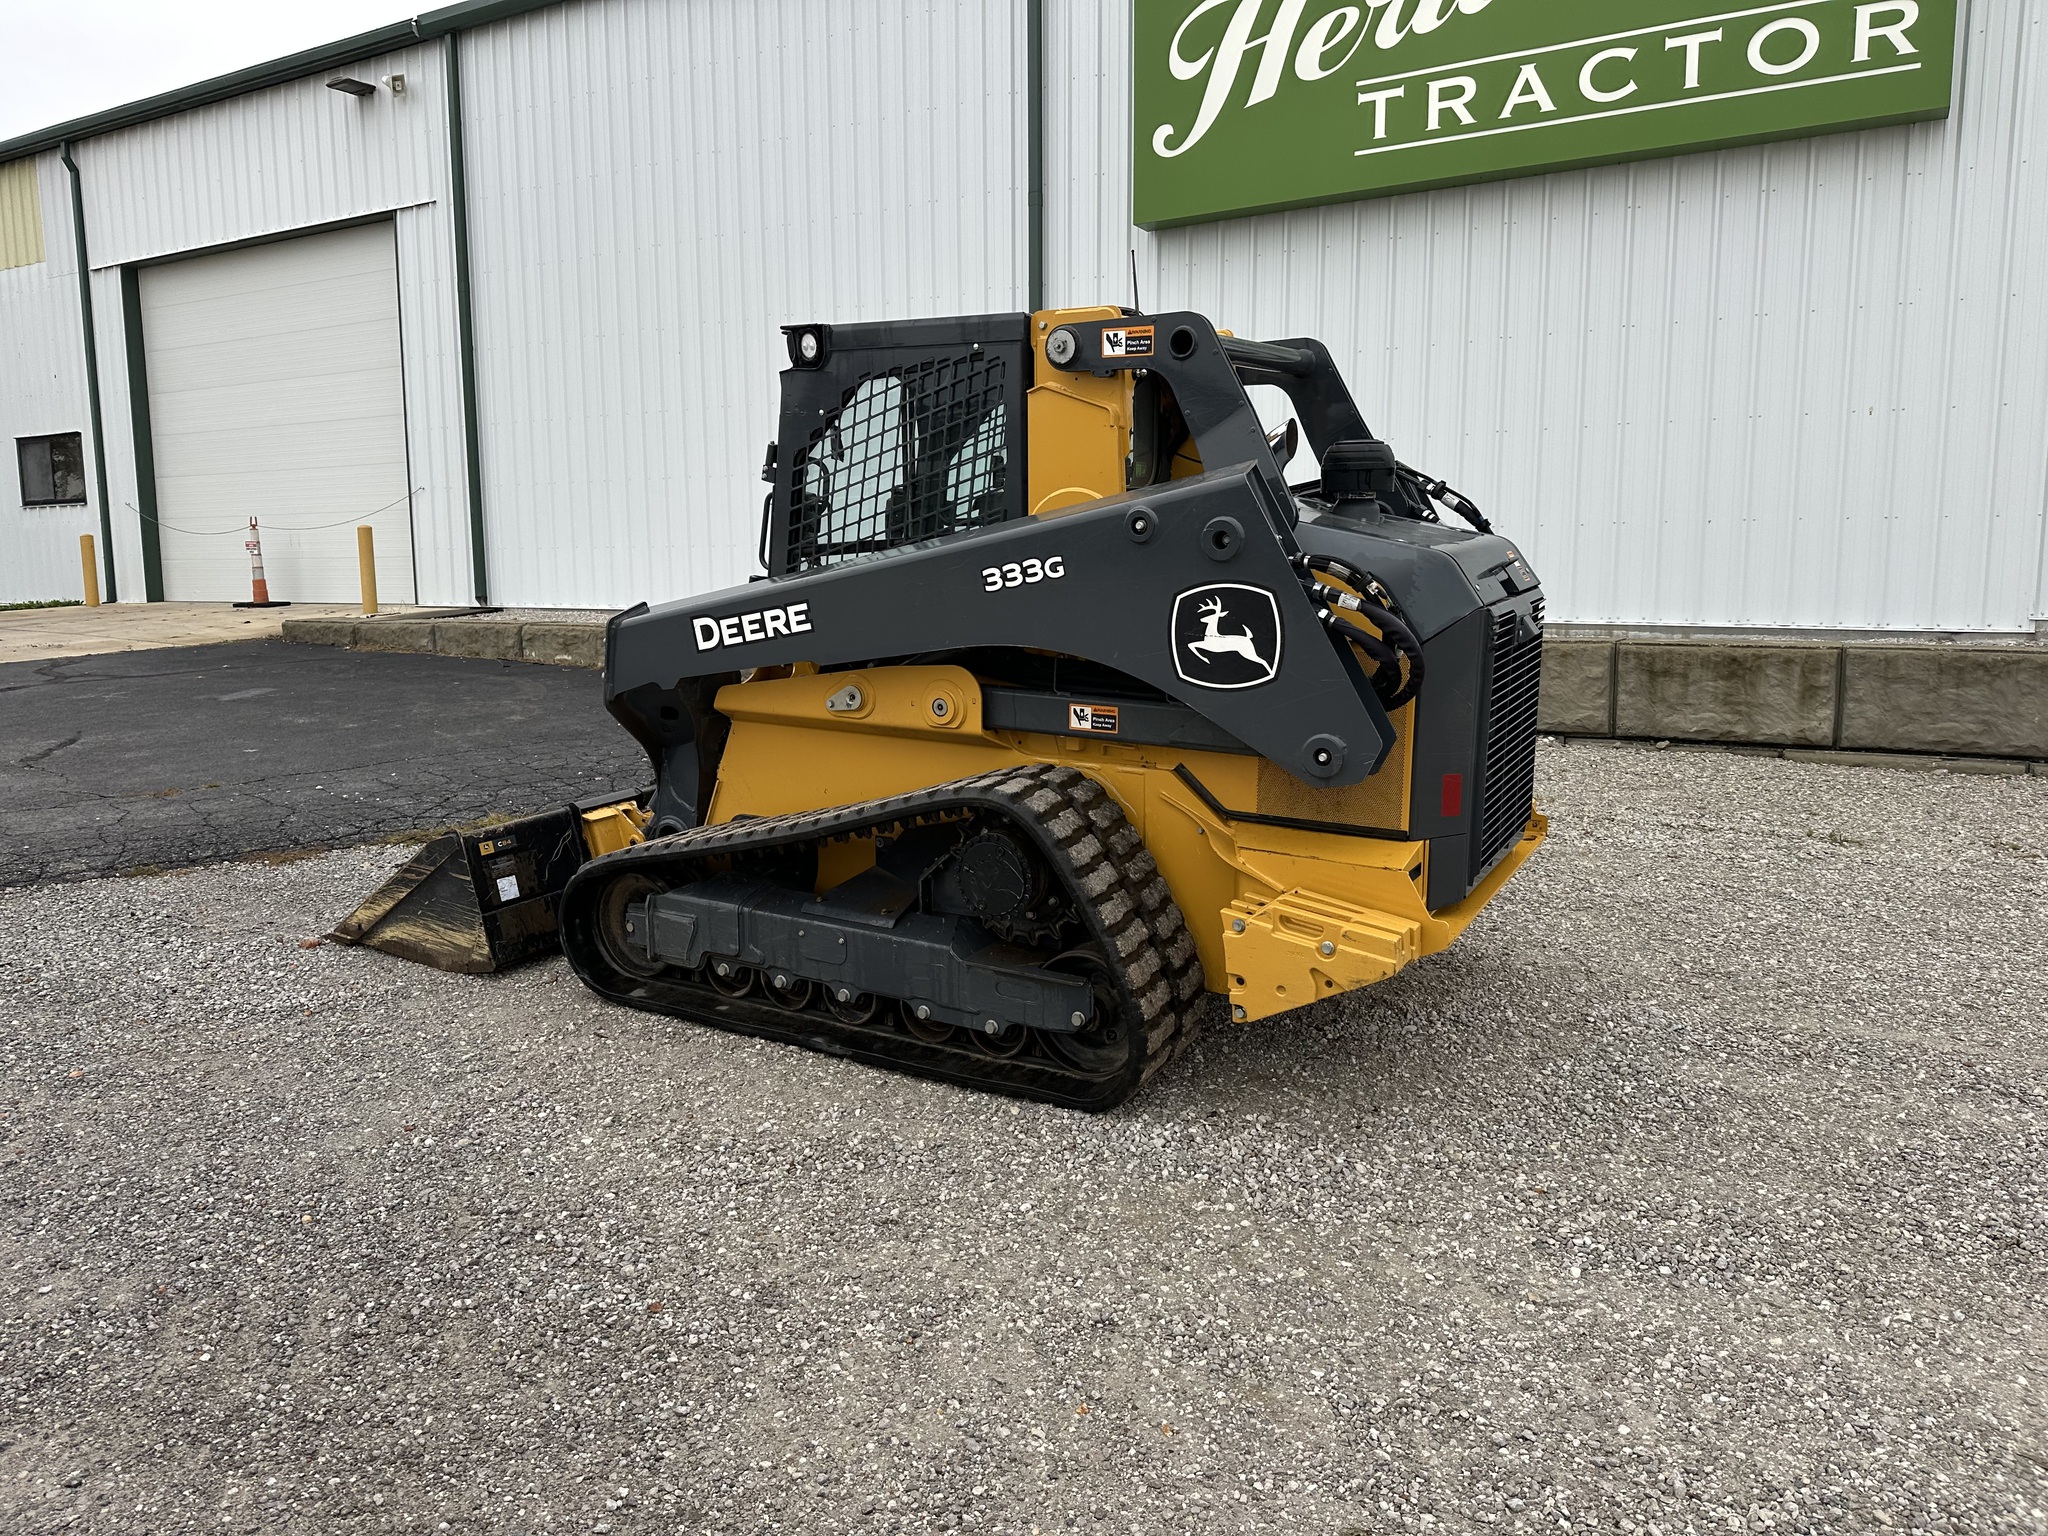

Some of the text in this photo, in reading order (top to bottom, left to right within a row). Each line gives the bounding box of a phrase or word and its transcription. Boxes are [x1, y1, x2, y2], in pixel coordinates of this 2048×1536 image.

[1357, 0, 1920, 139] TRACTOR
[982, 556, 1065, 592] 333G
[692, 602, 812, 650] DEERE
